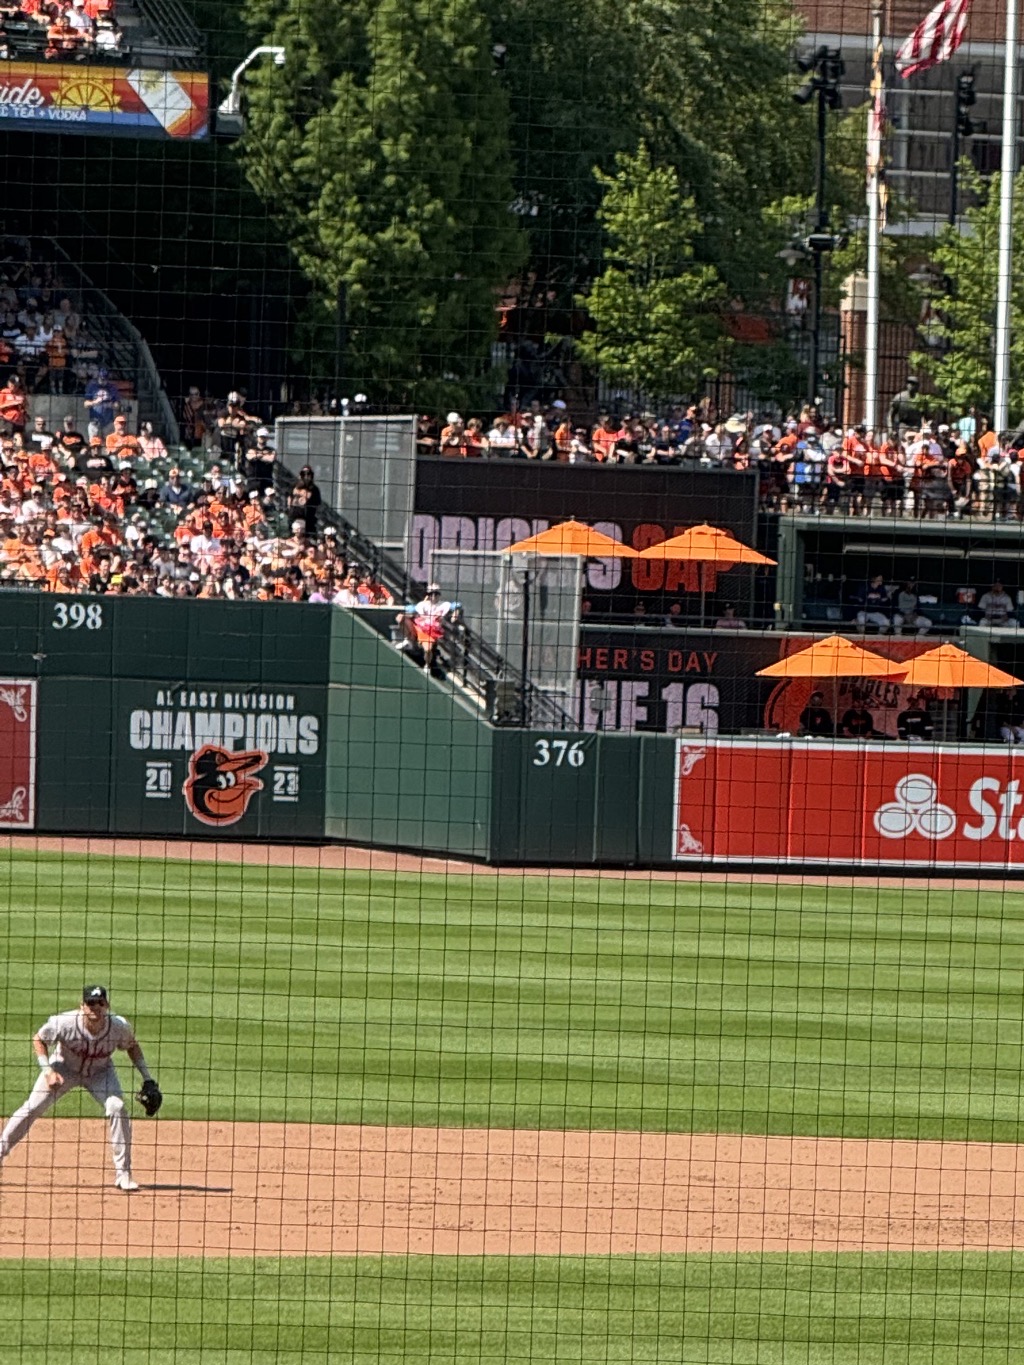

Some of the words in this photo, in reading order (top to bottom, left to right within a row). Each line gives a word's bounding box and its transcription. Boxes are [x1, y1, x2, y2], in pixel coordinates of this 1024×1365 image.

[12, 107, 35, 118] TEA
[49, 109, 87, 121] VODKA
[52, 602, 102, 630] 398
[577, 648, 655, 672] HER'S
[667, 651, 719, 673] DAY
[156, 690, 174, 707] AL
[180, 690, 218, 708] EAST
[224, 692, 296, 710] DIVISION
[661, 682, 720, 735] 16
[130, 709, 319, 755] CHAMPIONS
[533, 738, 586, 768] 376
[146, 768, 172, 791] 20
[273, 772, 299, 795] 23
